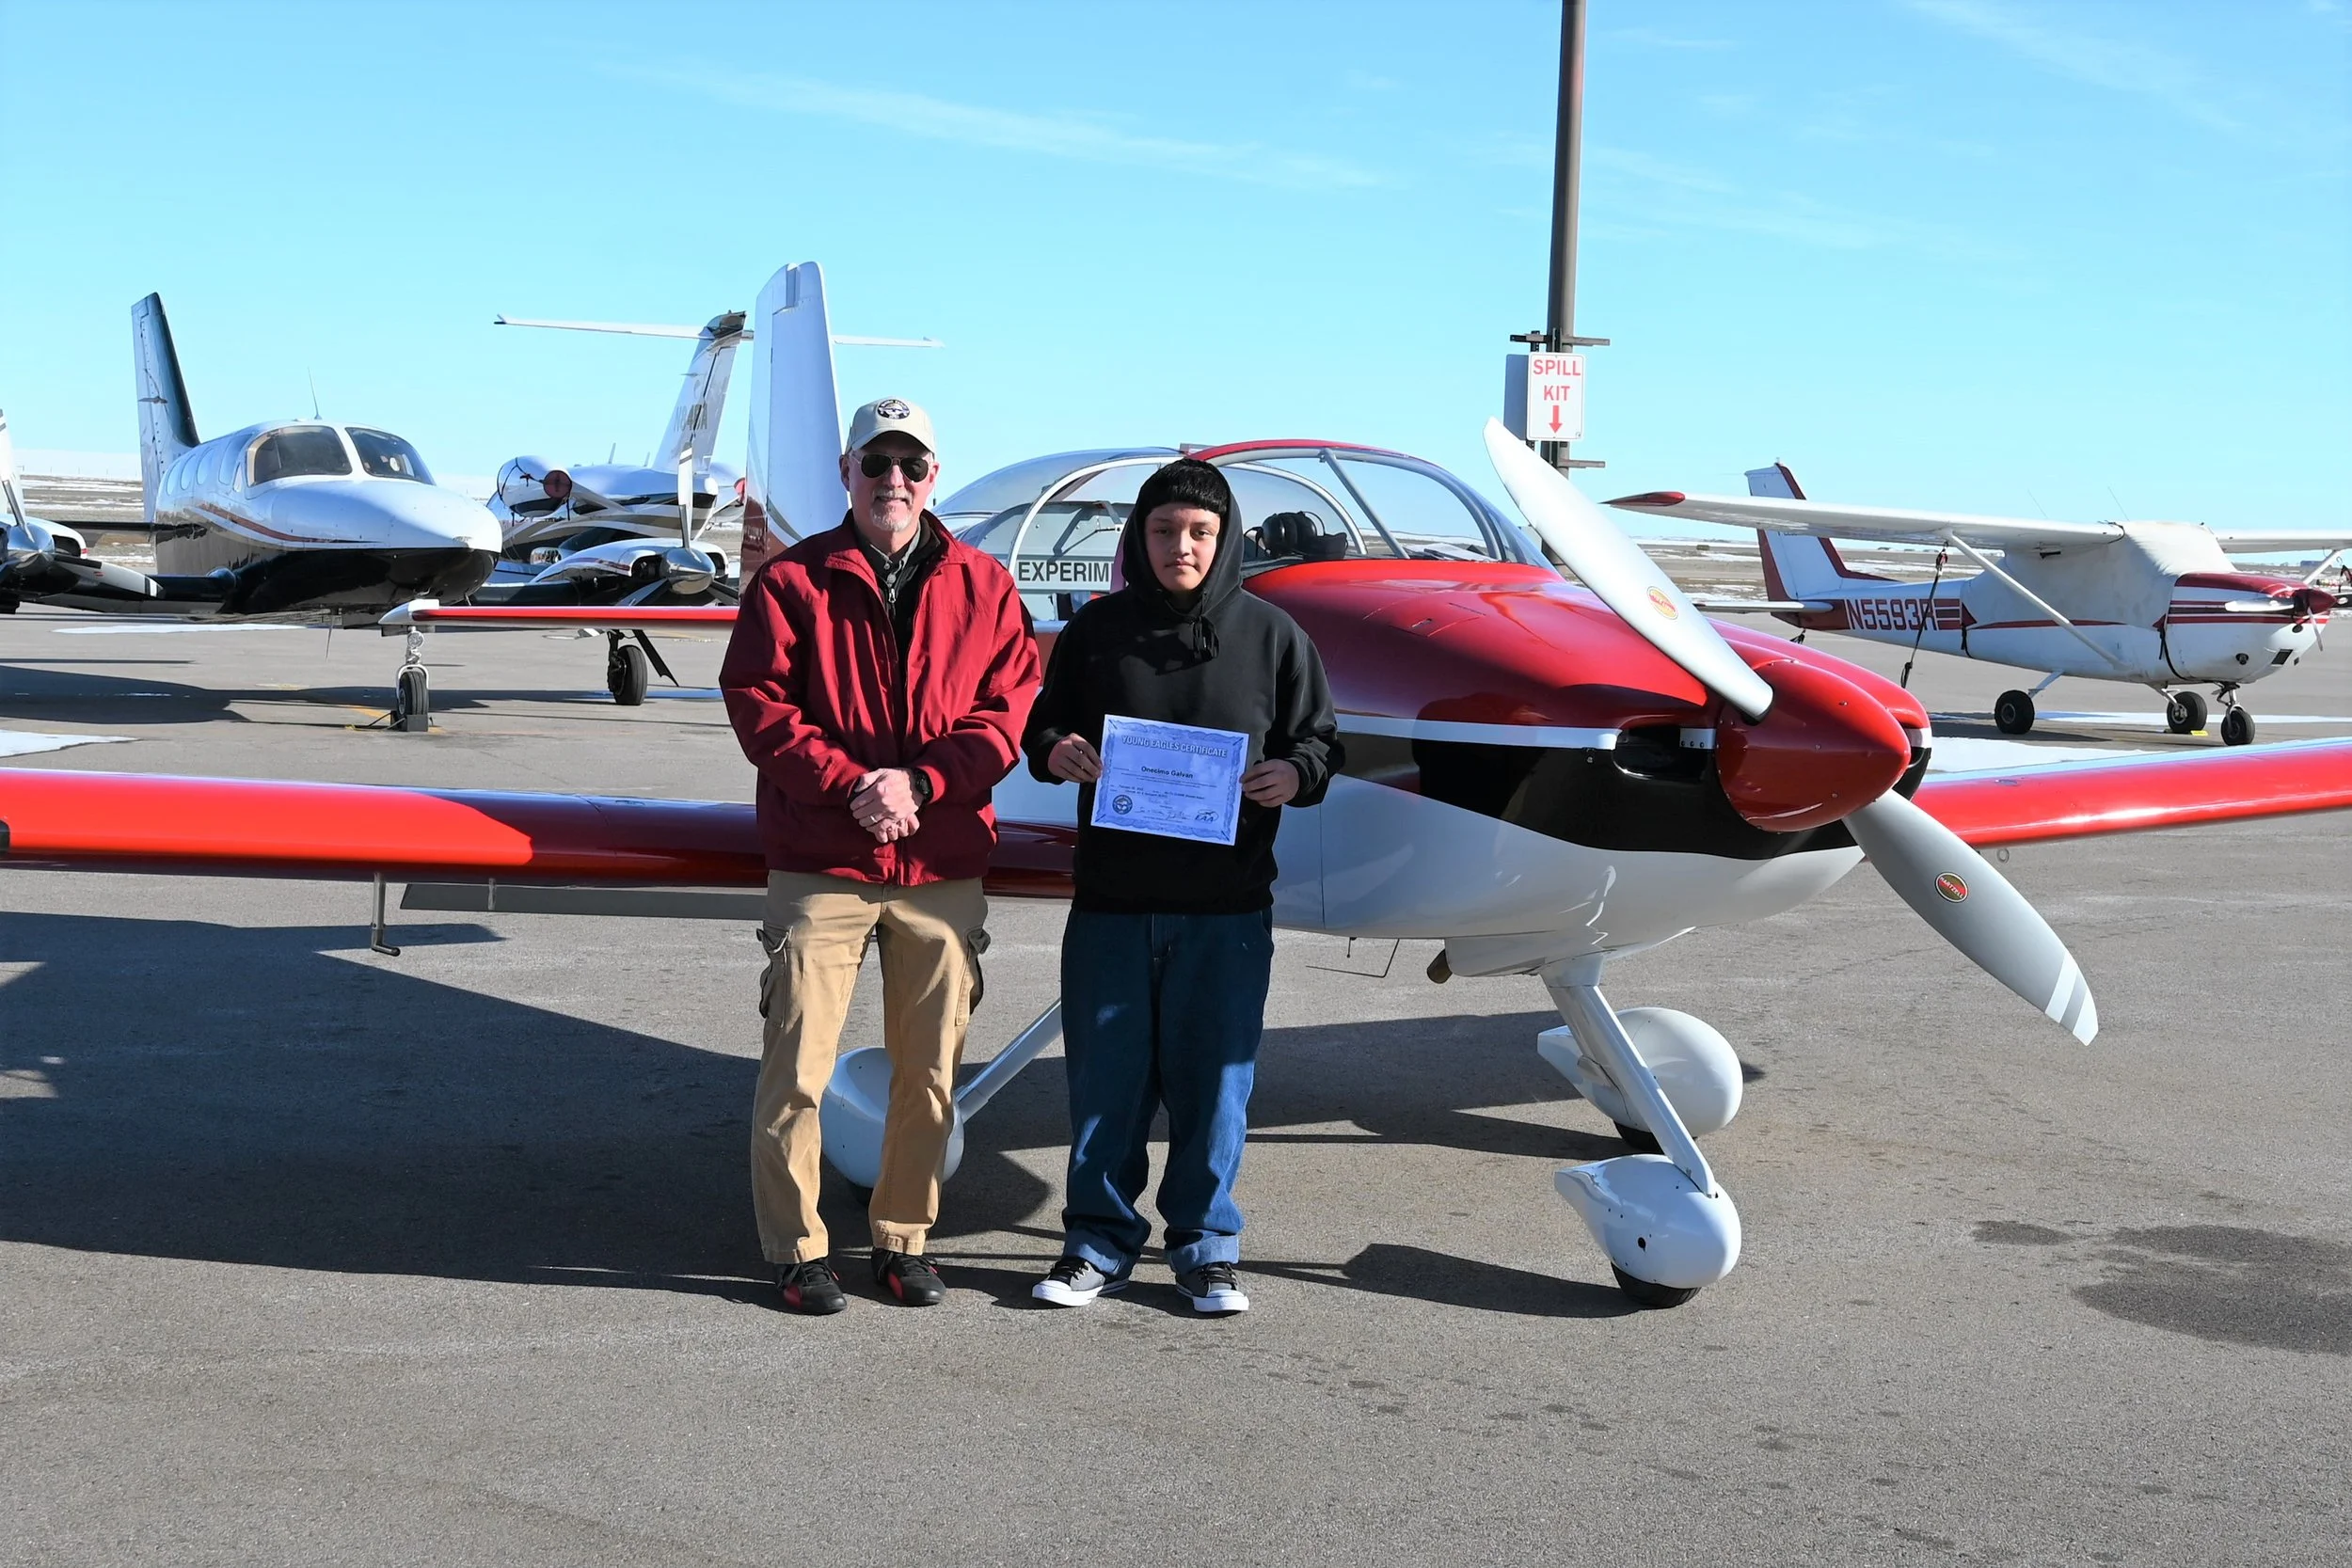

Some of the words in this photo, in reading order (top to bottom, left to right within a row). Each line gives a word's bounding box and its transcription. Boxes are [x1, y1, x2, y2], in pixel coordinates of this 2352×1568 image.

[1533, 358, 1581, 376] SPILL
[1543, 385, 1571, 401] KIT
[1018, 562, 1109, 582] EXPERIM
[1121, 735, 1150, 748] YOUNG
[1151, 738, 1180, 752] EAGLES
[1181, 743, 1228, 758] CERTIFICATE
[1141, 766, 1169, 776] Onecimo
[1170, 769, 1194, 780] Galvan
